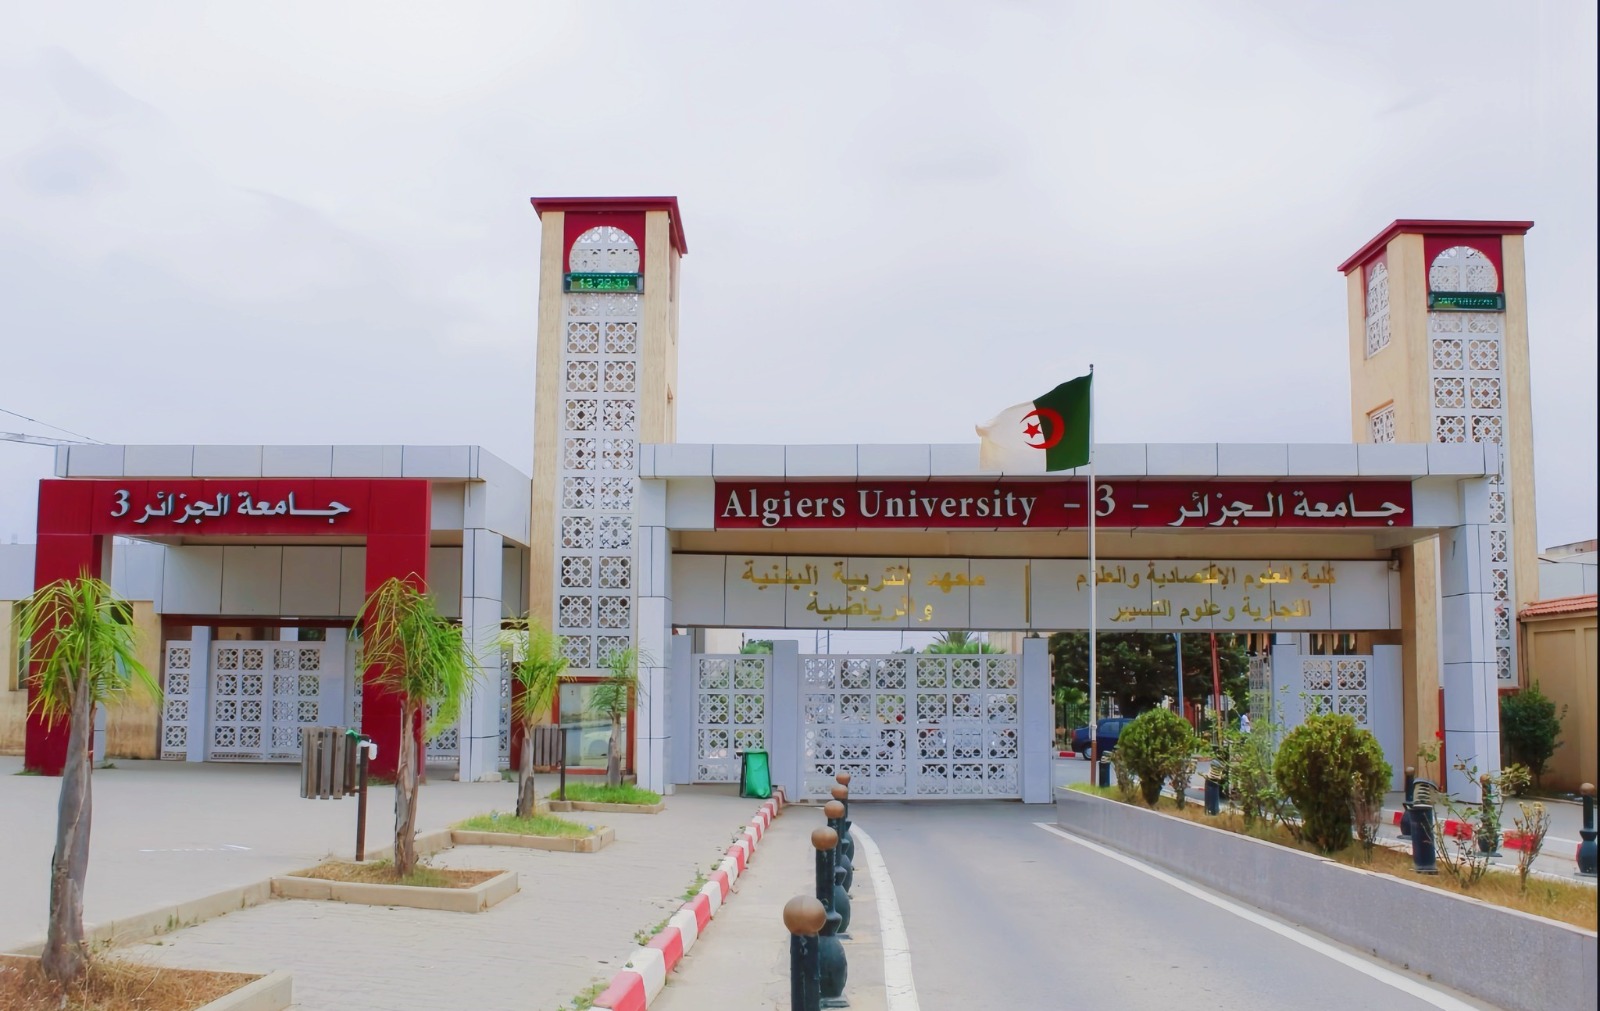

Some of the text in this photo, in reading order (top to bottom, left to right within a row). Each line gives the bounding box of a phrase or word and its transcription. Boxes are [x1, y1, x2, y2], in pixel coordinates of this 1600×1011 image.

[110, 489, 352, 524] جامعة الجزائر 3
[721, 489, 846, 527] Algiers
[857, 489, 1037, 526] University
[1095, 484, 1116, 517] 3
[1168, 490, 1405, 526] جامعة الجزائر
[832, 561, 911, 592] التربية
[927, 570, 986, 594] معهد
[1244, 562, 1293, 592] العلوم
[1301, 562, 1337, 589] كلية
